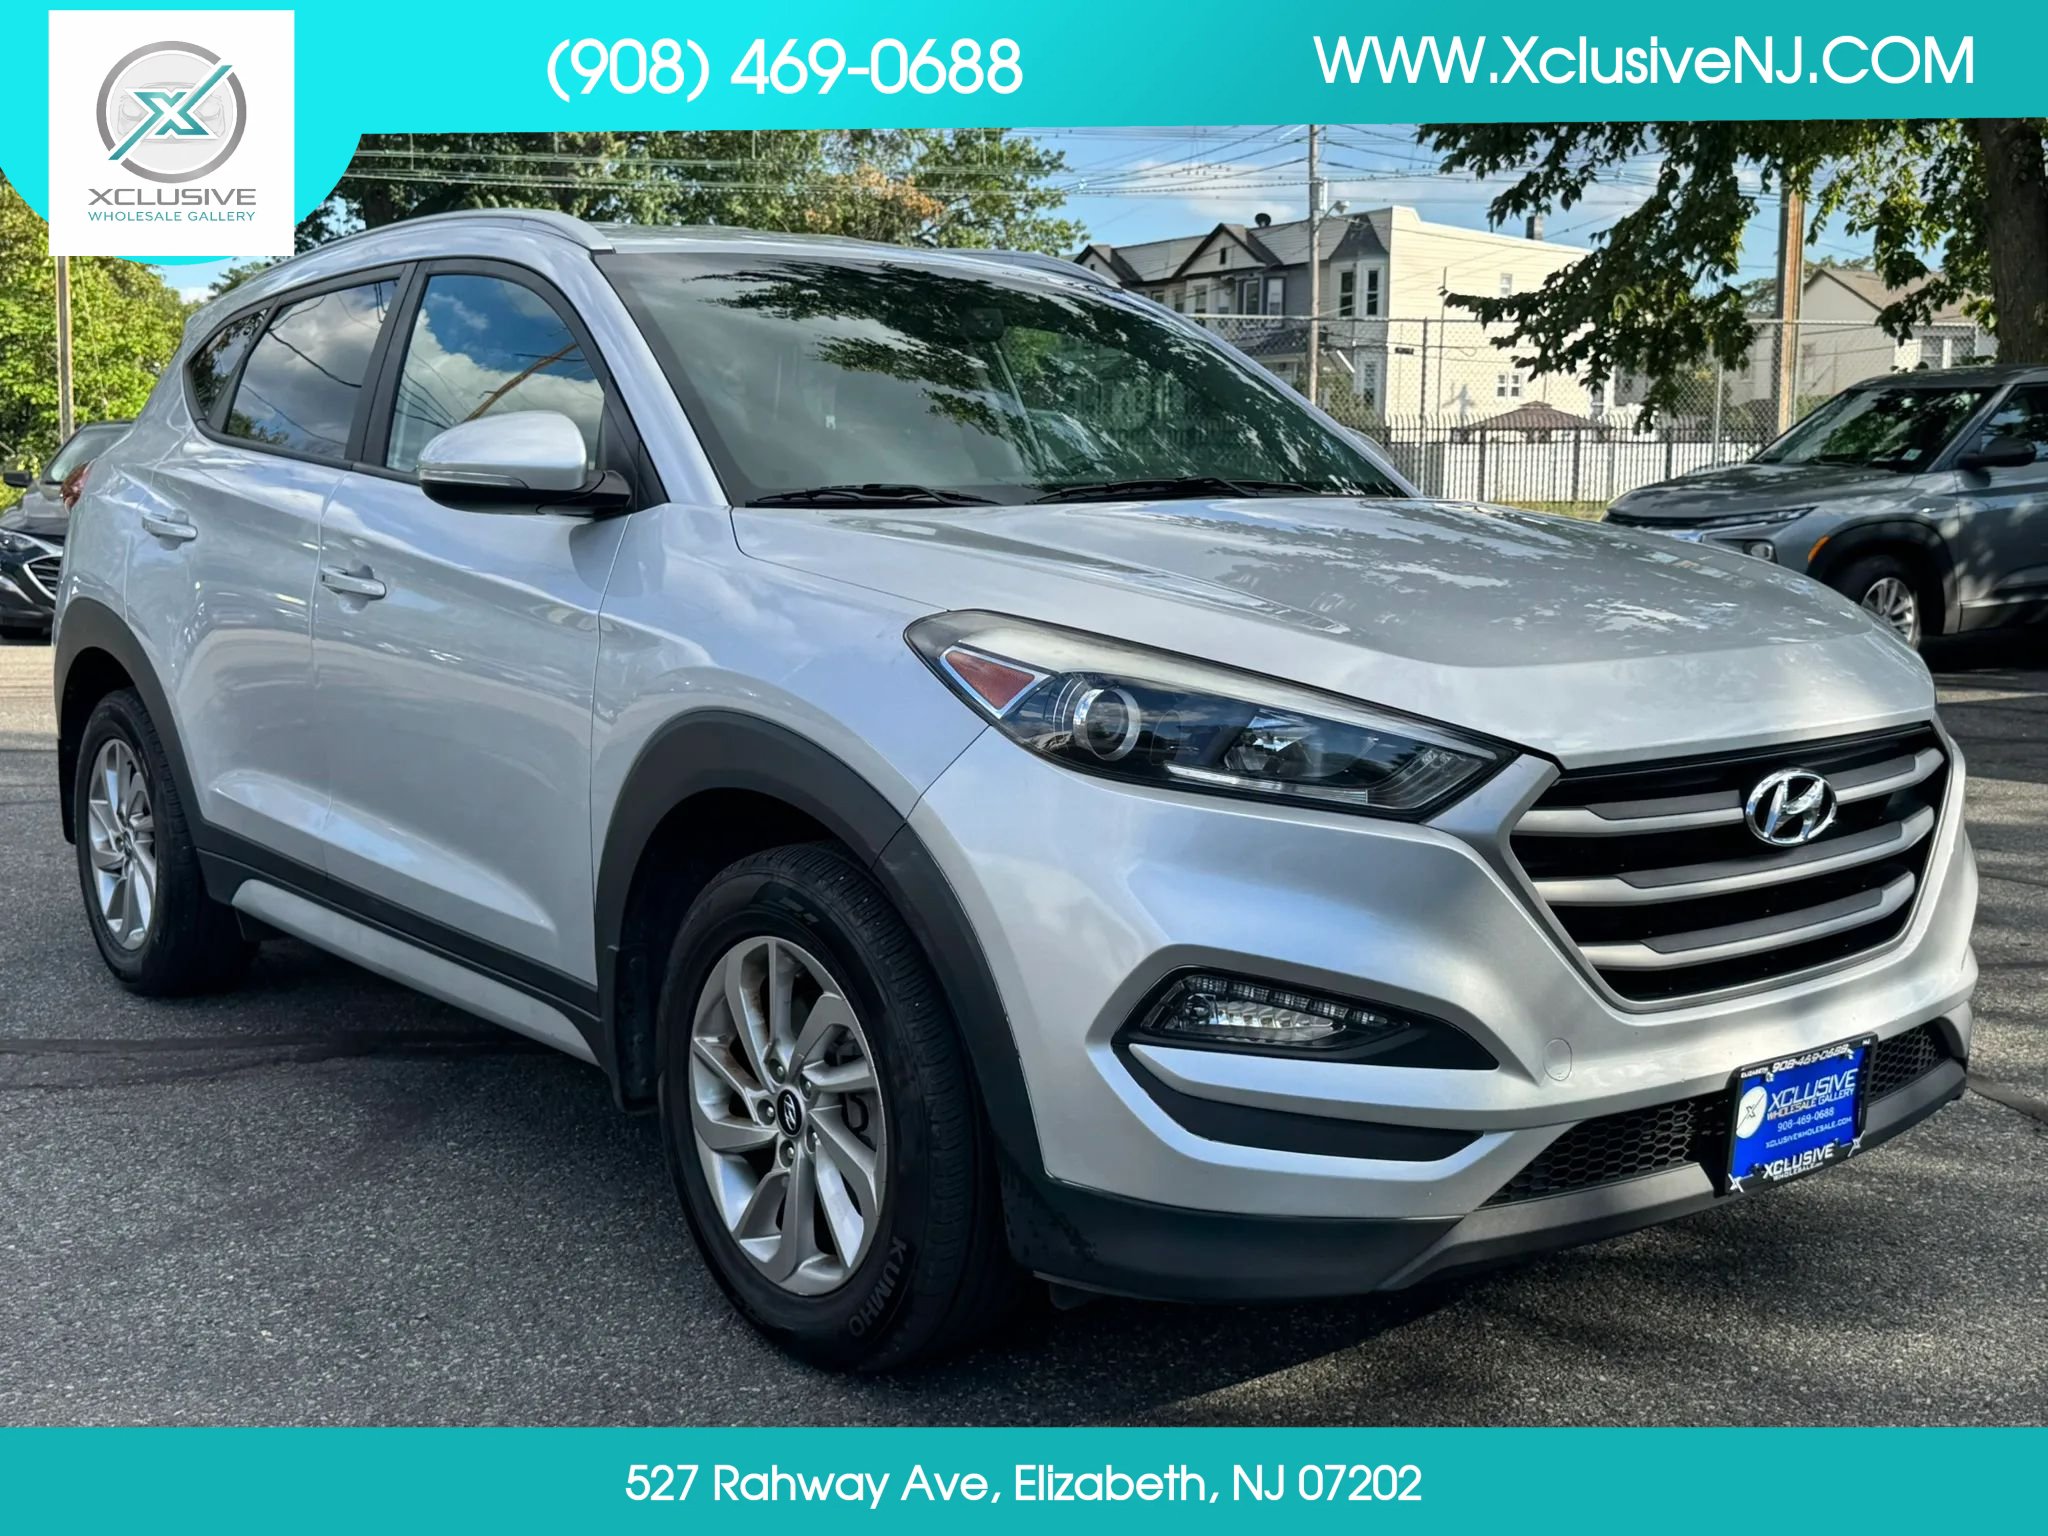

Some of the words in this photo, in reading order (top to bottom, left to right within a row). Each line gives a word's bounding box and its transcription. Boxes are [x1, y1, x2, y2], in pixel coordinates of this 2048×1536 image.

[1767, 1099, 1817, 1120] WHOLESALE
[1818, 1088, 1854, 1105] GALLERY
[1768, 1068, 1859, 1112] XCLUSIVE
[1777, 1107, 1835, 1132] 908-469-0688
[1763, 1143, 1835, 1179] XCLUSIVE
[848, 1236, 908, 1338] KUMHO
